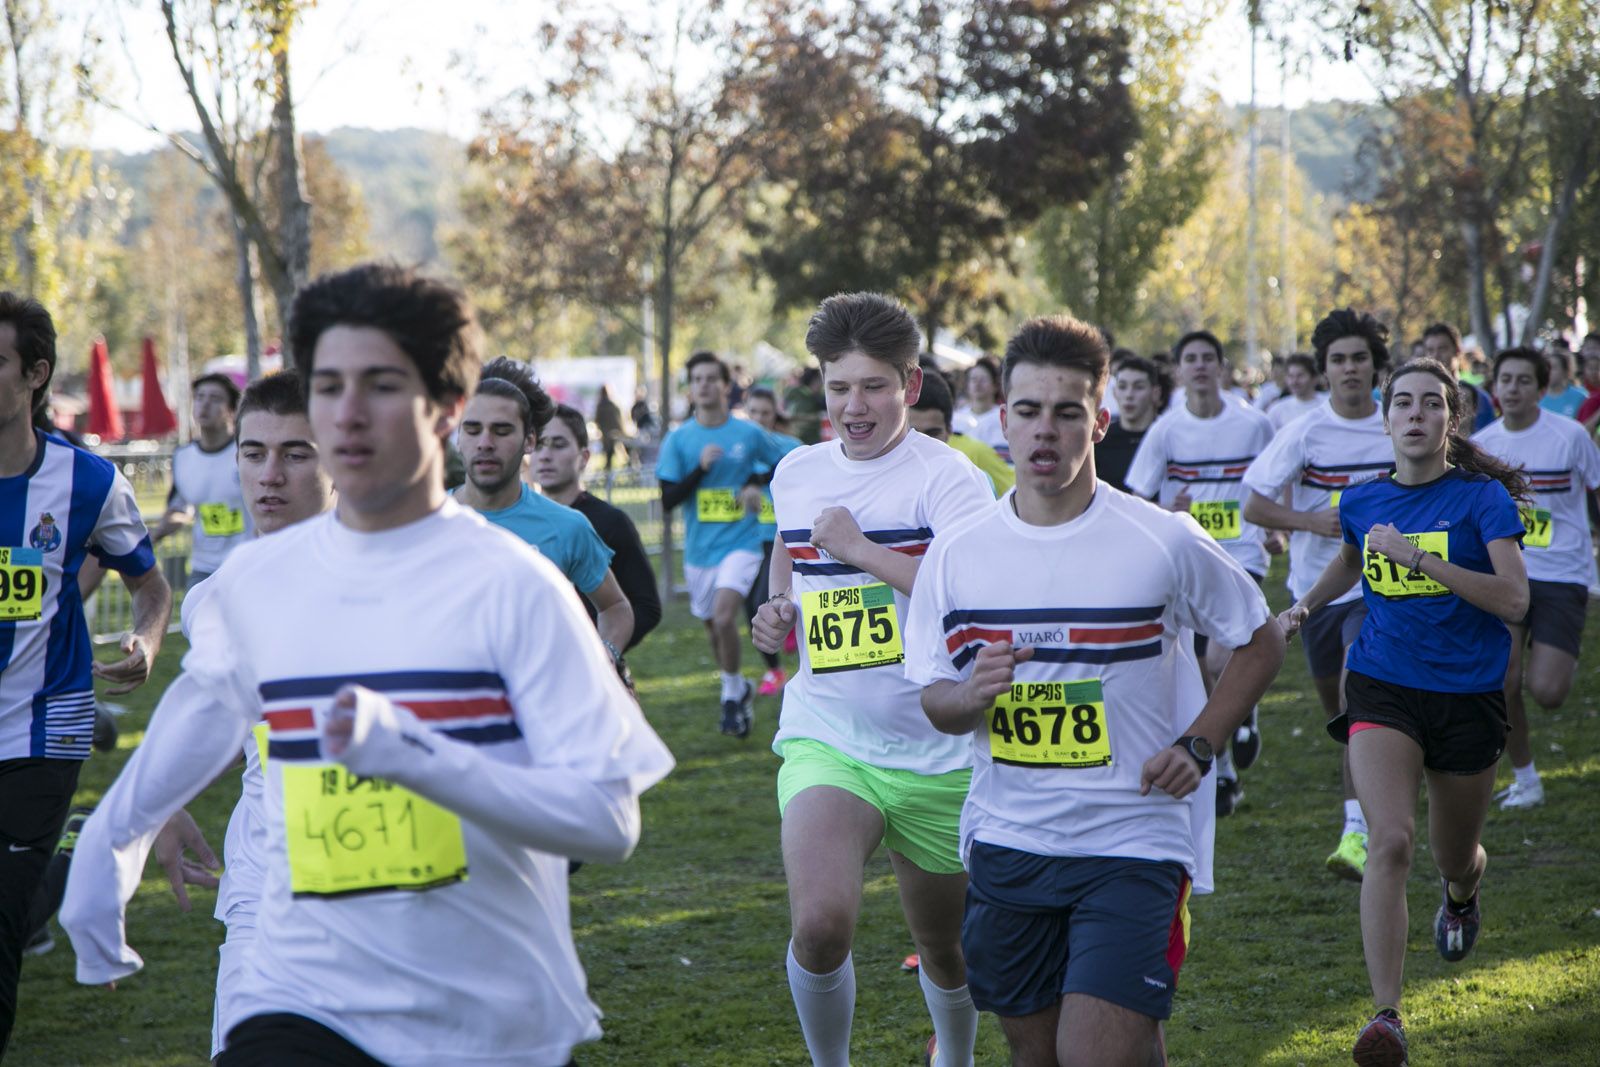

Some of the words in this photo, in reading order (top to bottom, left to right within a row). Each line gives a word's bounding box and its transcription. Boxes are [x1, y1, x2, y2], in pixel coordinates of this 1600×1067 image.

[1191, 510, 1235, 530] 691
[818, 591, 829, 609] 19
[808, 606, 894, 652] 4675
[1018, 627, 1064, 644] VIARÓ
[1010, 684, 1023, 702] 19
[1027, 683, 1062, 702] CROS
[991, 704, 1101, 746] 4678
[304, 799, 418, 858] 4671
